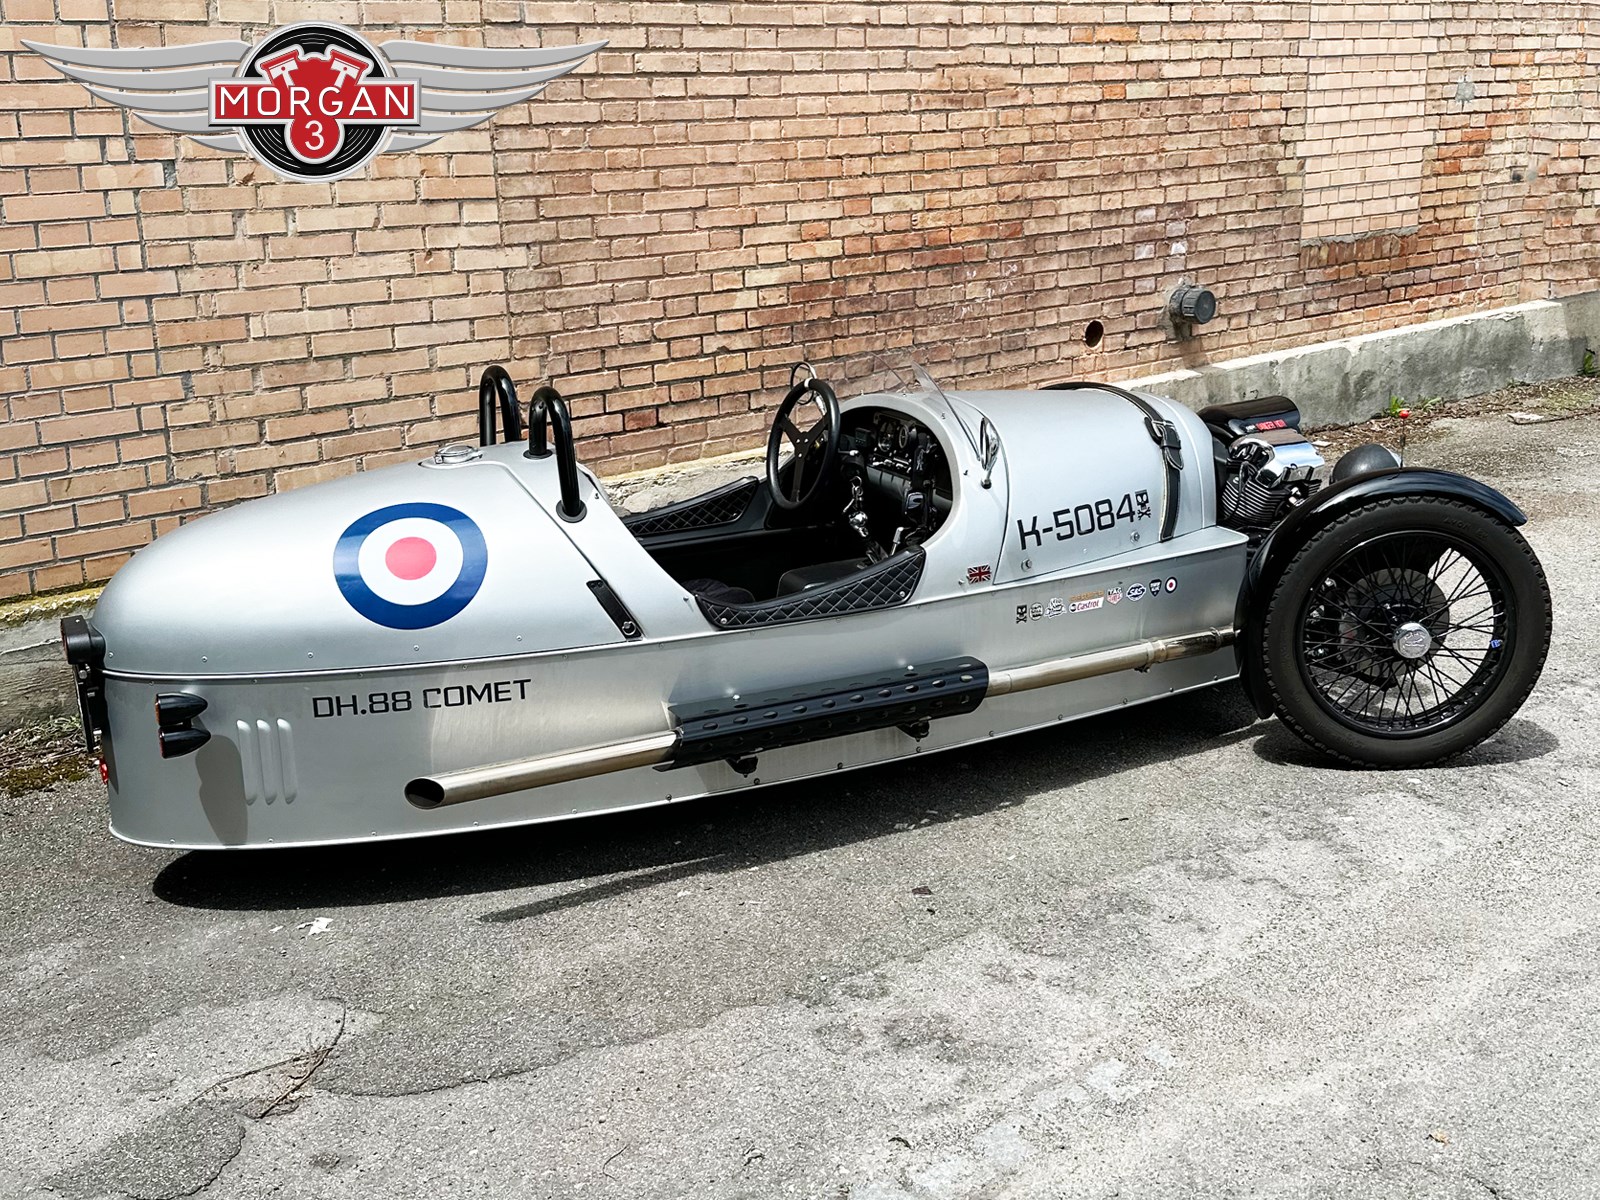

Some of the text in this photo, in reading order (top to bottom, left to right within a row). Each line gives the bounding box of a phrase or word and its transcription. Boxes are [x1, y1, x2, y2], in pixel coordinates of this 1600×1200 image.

[1016, 493, 1136, 550] K-5084
[1076, 600, 1099, 611] Castrol
[312, 678, 532, 718] DH.88 COMET
